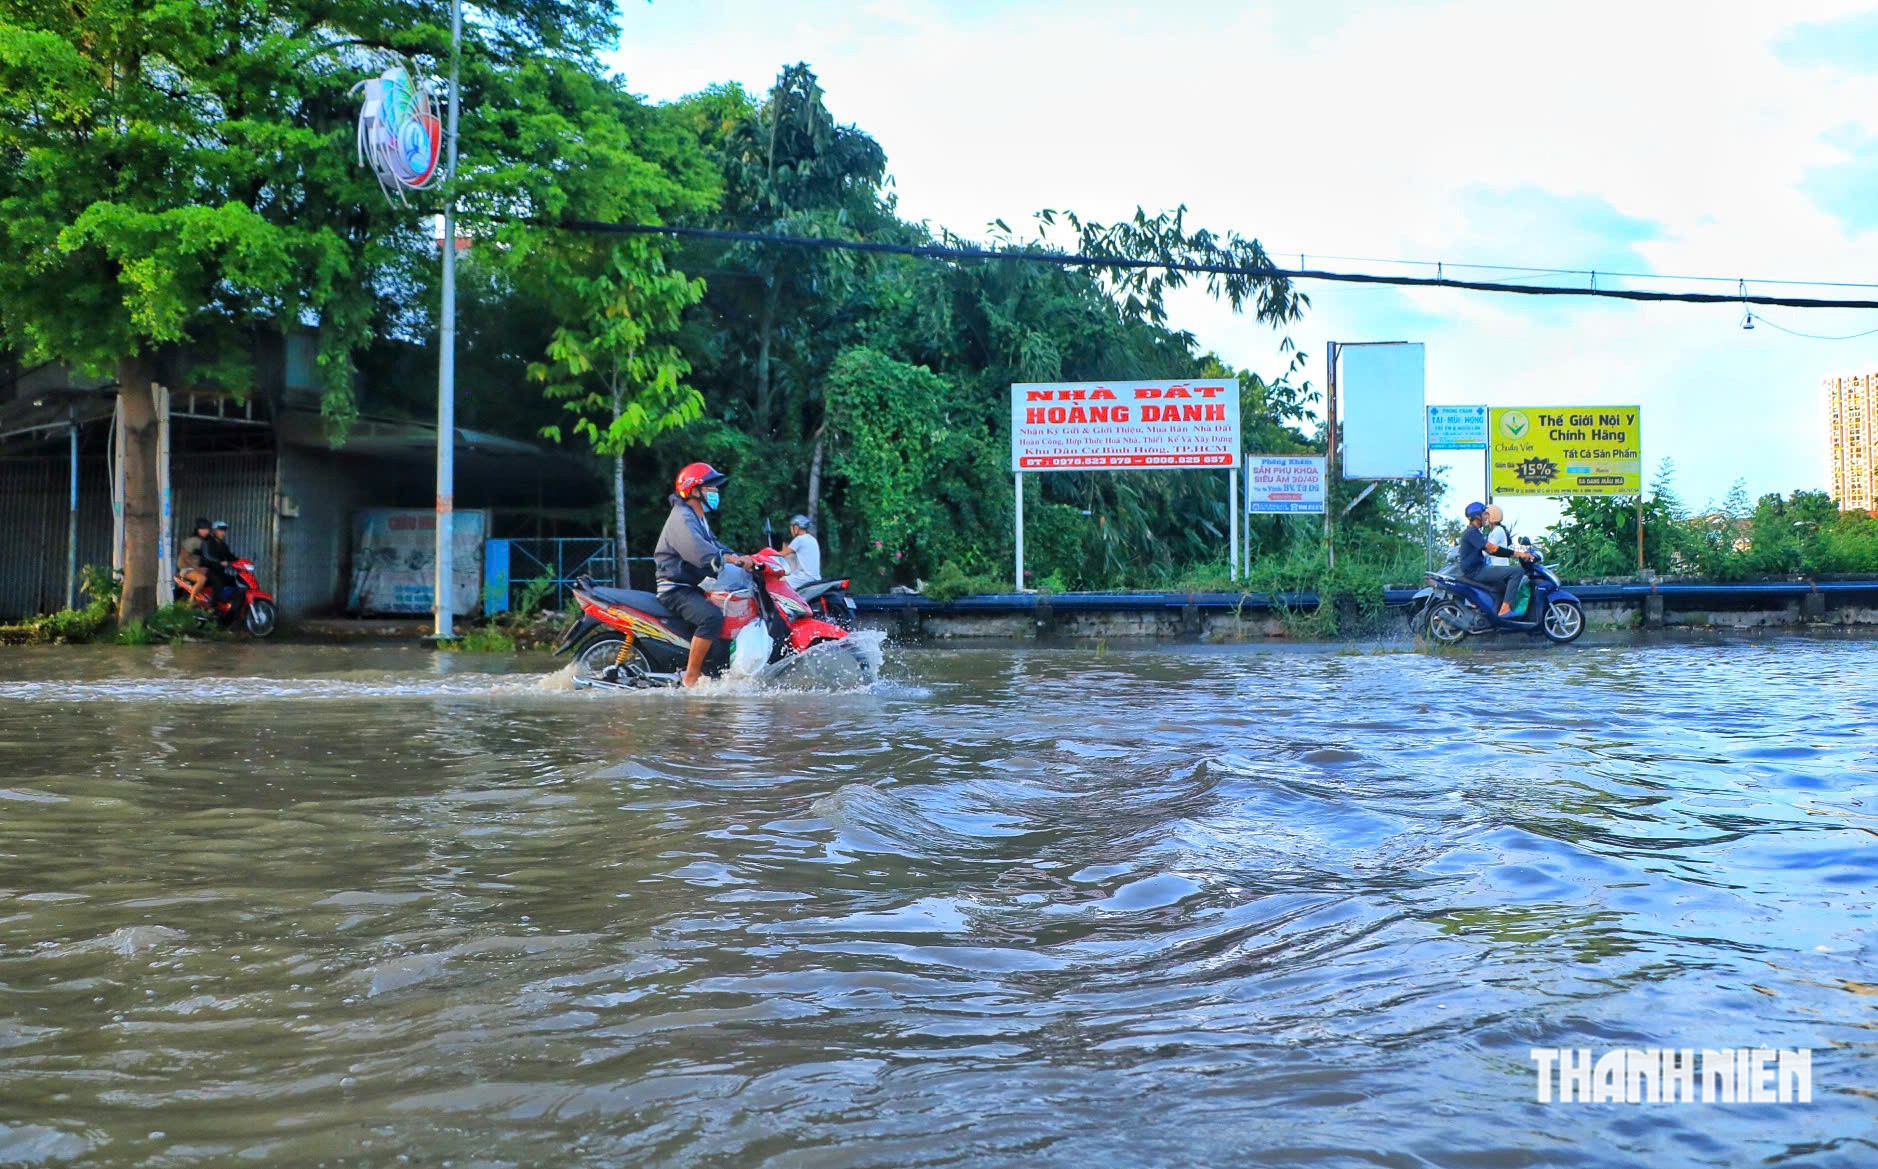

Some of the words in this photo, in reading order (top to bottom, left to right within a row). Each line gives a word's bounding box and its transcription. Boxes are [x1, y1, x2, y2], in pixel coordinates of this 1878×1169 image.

[1026, 386, 1117, 401] NHÀ
[1134, 383, 1225, 399] ĐẤT
[1026, 401, 1129, 424] HOÀNG
[1141, 404, 1225, 422] DANH
[1538, 414, 1564, 427] Thế
[1569, 414, 1593, 427] Giới
[1599, 414, 1620, 429] Nội
[1549, 429, 1586, 441] Chính
[1025, 447, 1049, 455] Khu
[1053, 446, 1077, 454] Dân
[1082, 446, 1100, 454] Cư
[1102, 446, 1130, 454] Bình
[1563, 448, 1578, 458] Tất
[1580, 448, 1592, 458] Cả
[1593, 448, 1611, 458] Sản
[1612, 447, 1637, 458] Phẩm
[1253, 465, 1271, 474] SẢN
[1273, 467, 1292, 475] PHỤ
[1521, 463, 1552, 475] 15%
[1254, 475, 1273, 483] SIÊU
[1276, 475, 1290, 483] ÂM
